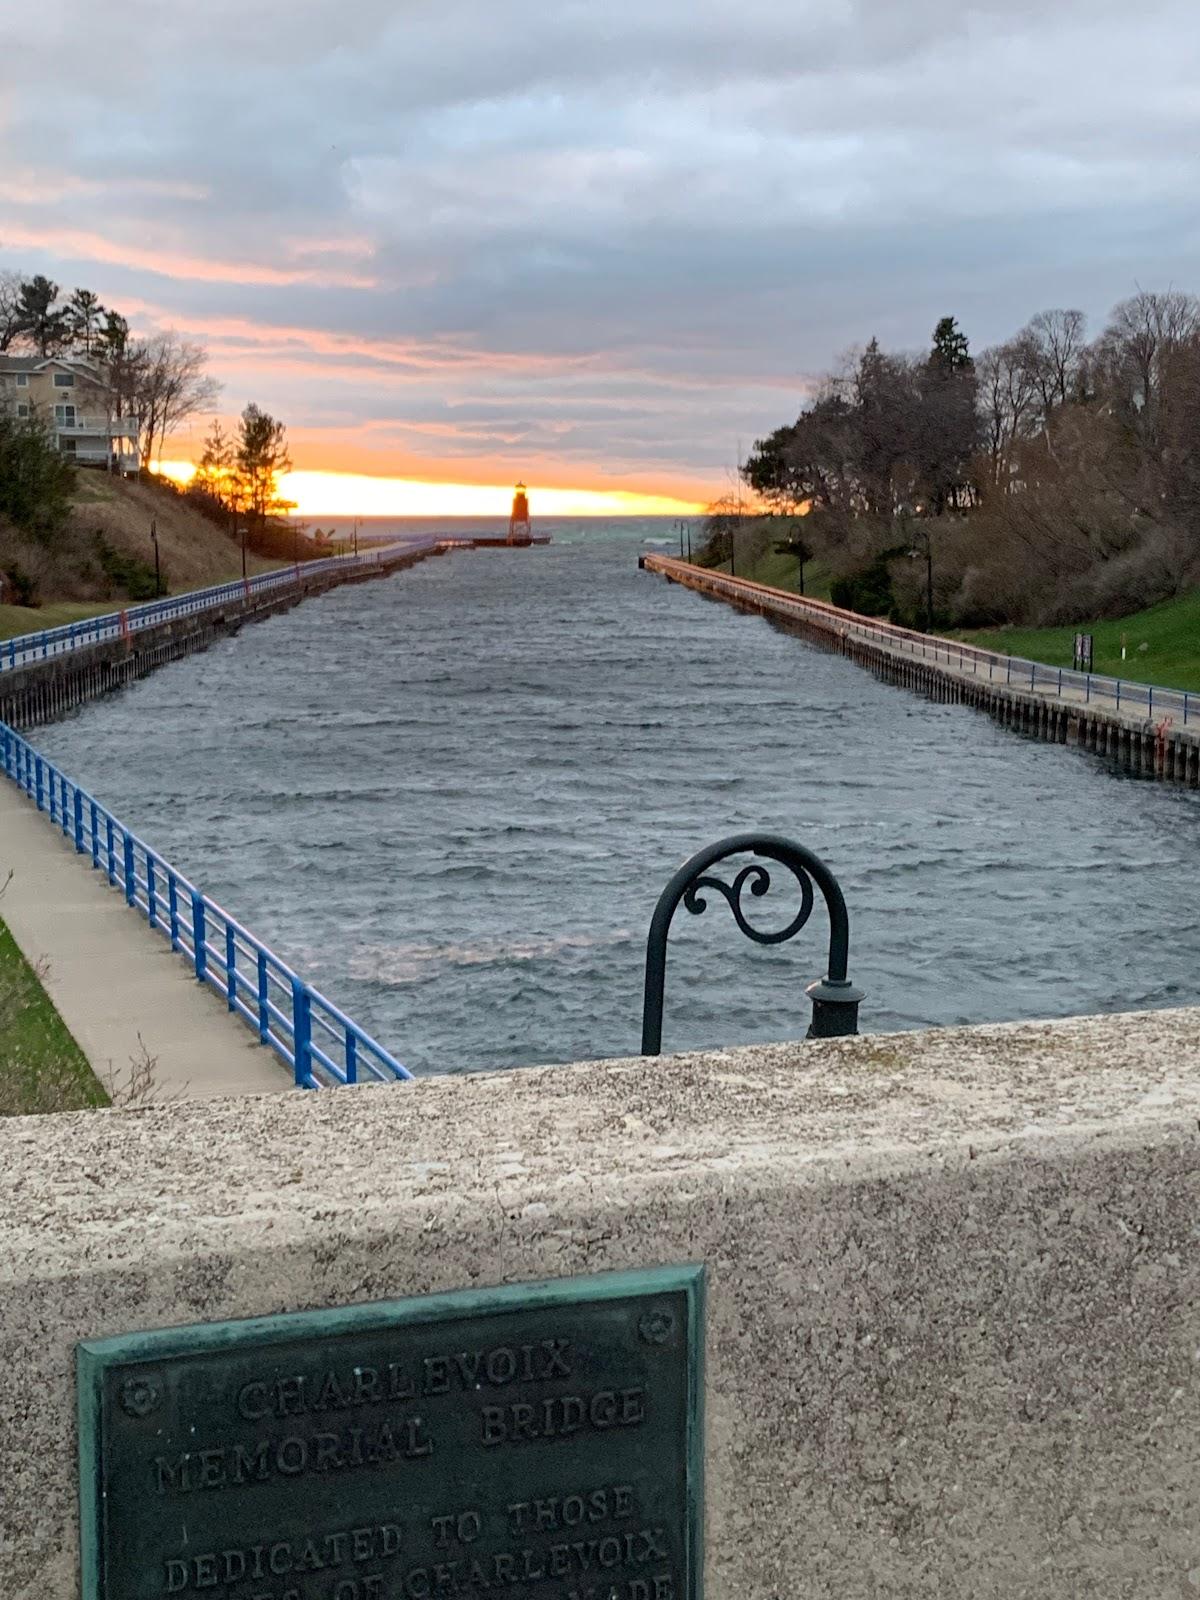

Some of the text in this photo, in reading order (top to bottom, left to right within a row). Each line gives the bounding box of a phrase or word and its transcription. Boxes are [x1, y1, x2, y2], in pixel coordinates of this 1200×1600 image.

[237, 1339, 573, 1420] CHARLEVOIX
[154, 1386, 645, 1495] MEMORIAL BRIDGE
[164, 1485, 634, 1593] DEDICATED TO THOSE
[336, 1526, 668, 1600] OF CHARLEVOIX
